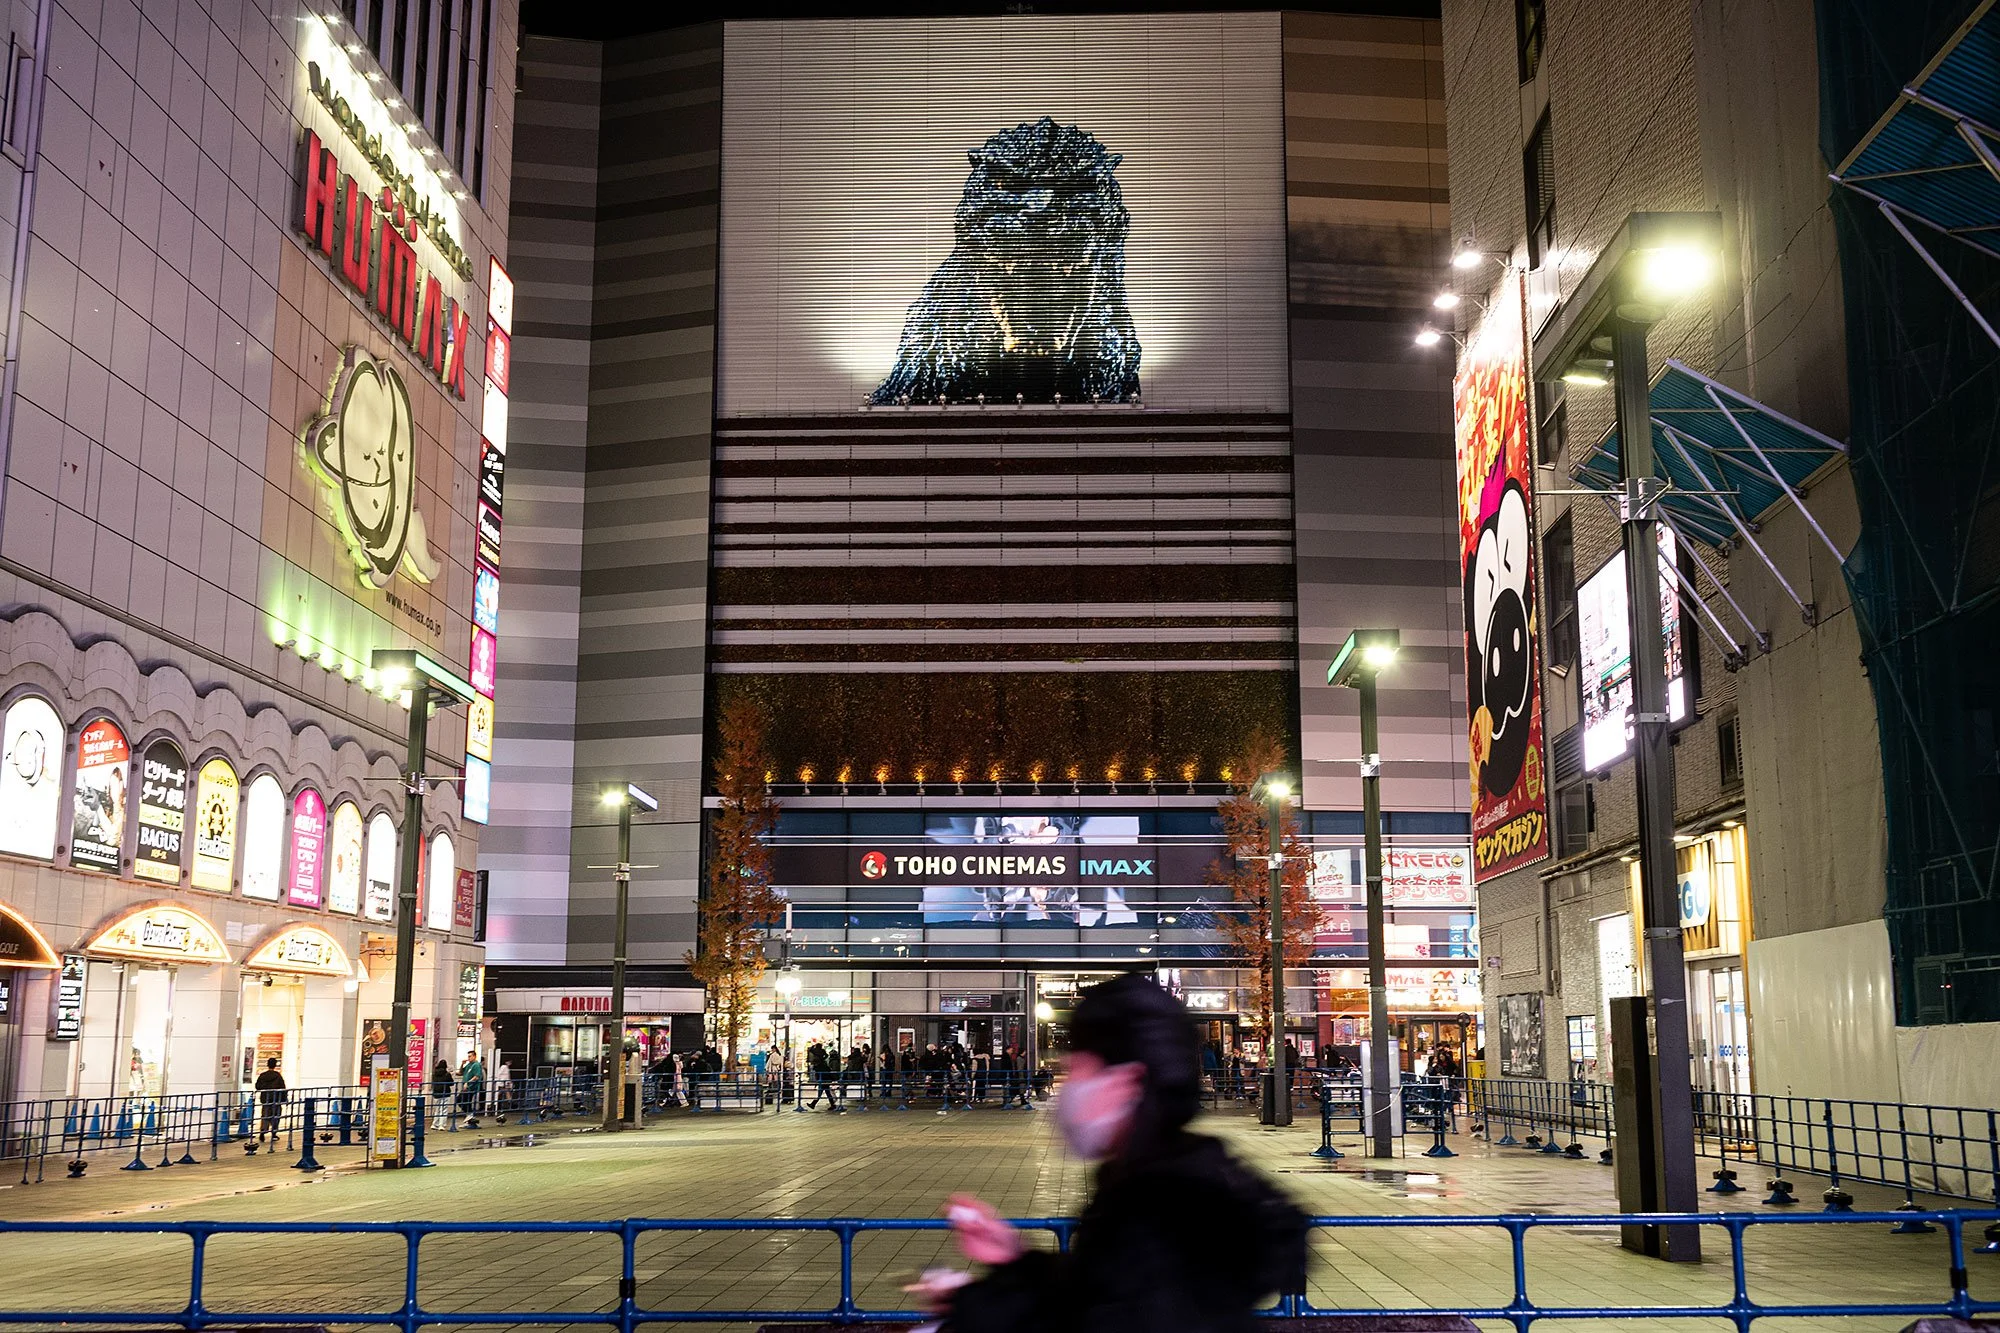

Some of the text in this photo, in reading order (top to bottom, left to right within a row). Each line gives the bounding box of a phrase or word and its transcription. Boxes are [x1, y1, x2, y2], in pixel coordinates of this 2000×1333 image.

[296, 127, 470, 402] HUMAX
[385, 590, 442, 638] www.humax.co.jp
[143, 759, 186, 788] ビリヤード
[140, 826, 180, 852] BAGUS
[1476, 810, 1543, 870] ヤングマガジン
[894, 856, 1153, 875] TOHO CINEMAS IMAX
[561, 997, 613, 1011] MARUHA
[1186, 993, 1226, 1007] KFC
